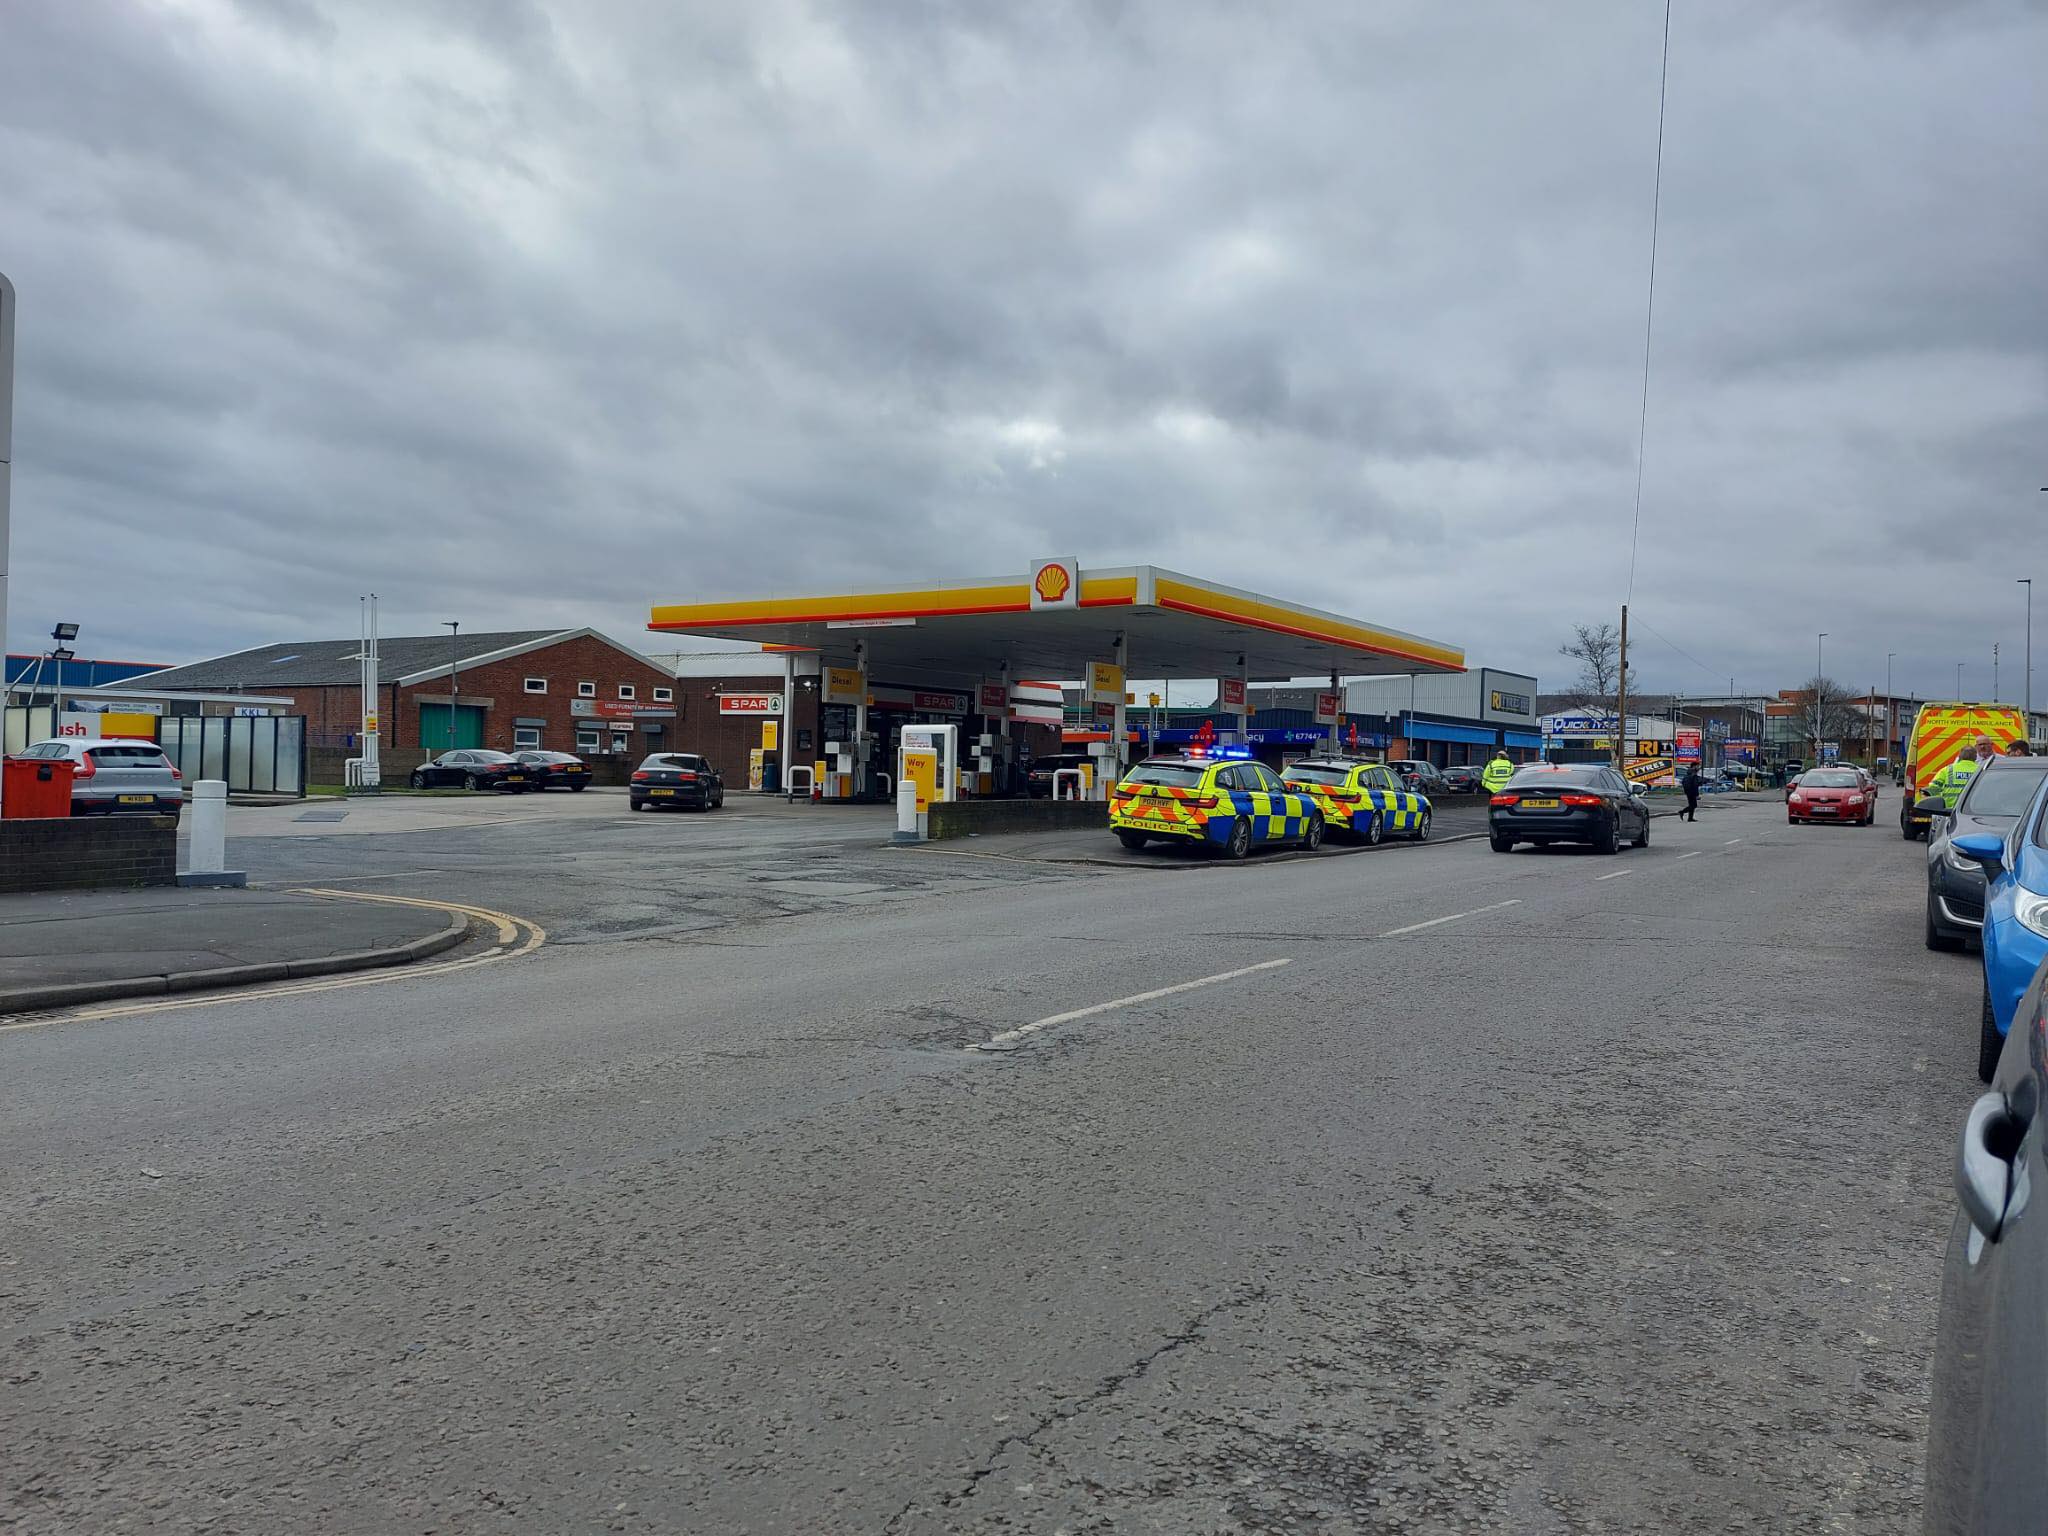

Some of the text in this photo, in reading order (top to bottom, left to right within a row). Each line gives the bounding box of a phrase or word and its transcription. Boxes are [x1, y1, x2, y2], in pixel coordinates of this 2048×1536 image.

[730, 698, 768, 709] SPAR
[923, 696, 955, 708] SPAR
[1639, 740, 1658, 756] RI
[907, 758, 926, 768] Way
[1634, 761, 1665, 775] TYRES
[906, 768, 914, 776] In
[1123, 819, 1180, 832] POLICE
